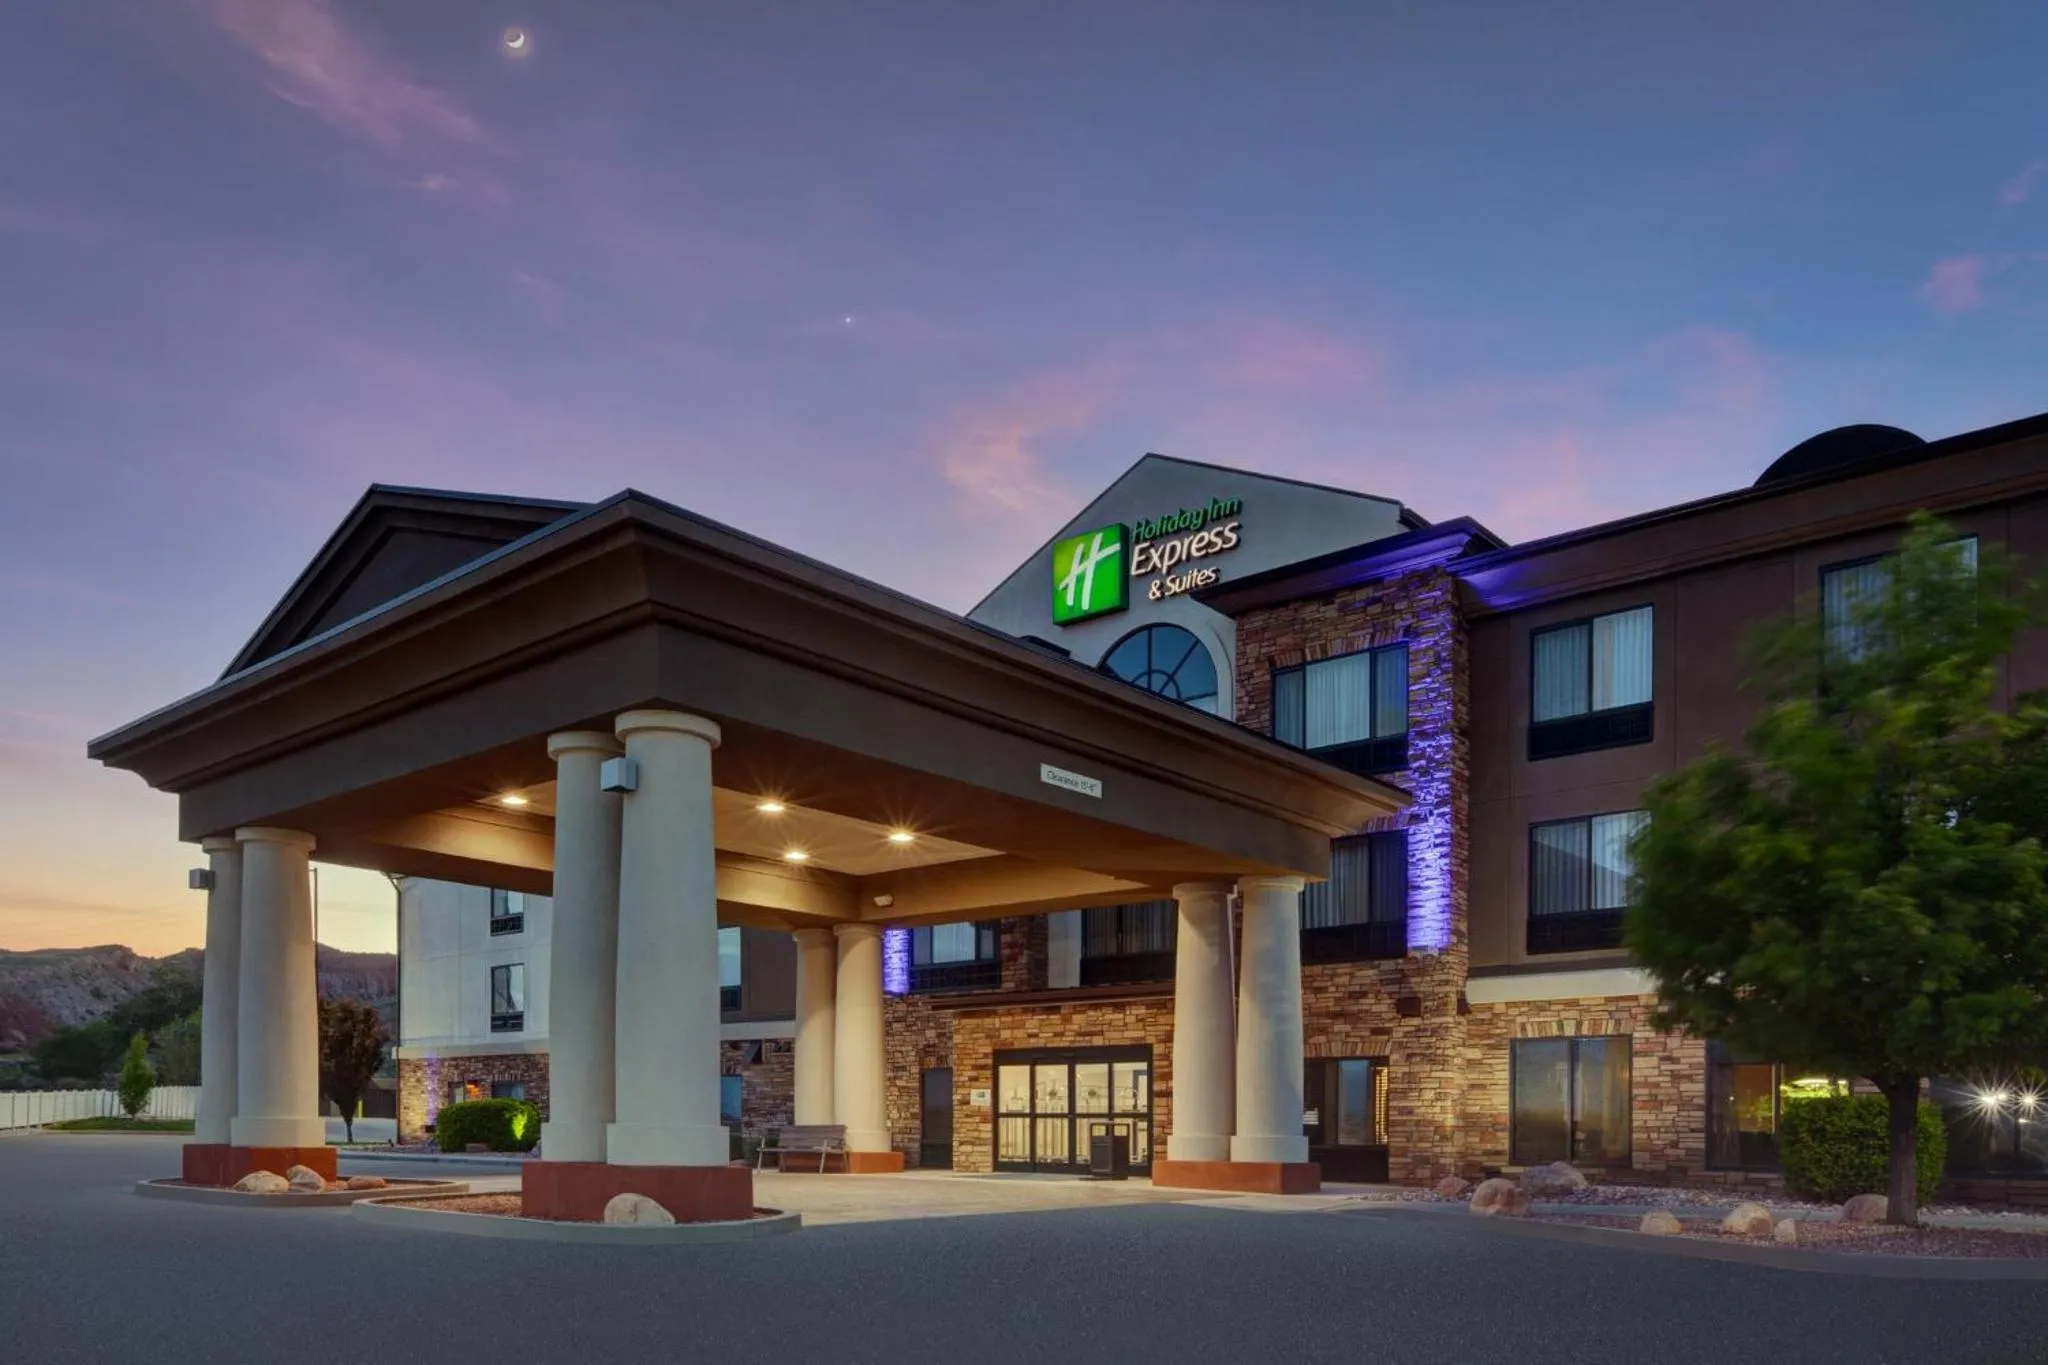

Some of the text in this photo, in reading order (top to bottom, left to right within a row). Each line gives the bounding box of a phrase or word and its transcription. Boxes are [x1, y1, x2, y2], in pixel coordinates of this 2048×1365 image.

[1132, 498, 1242, 541] Holiday Inn
[1131, 521, 1239, 575] Express
[1148, 567, 1217, 600] & Suites
